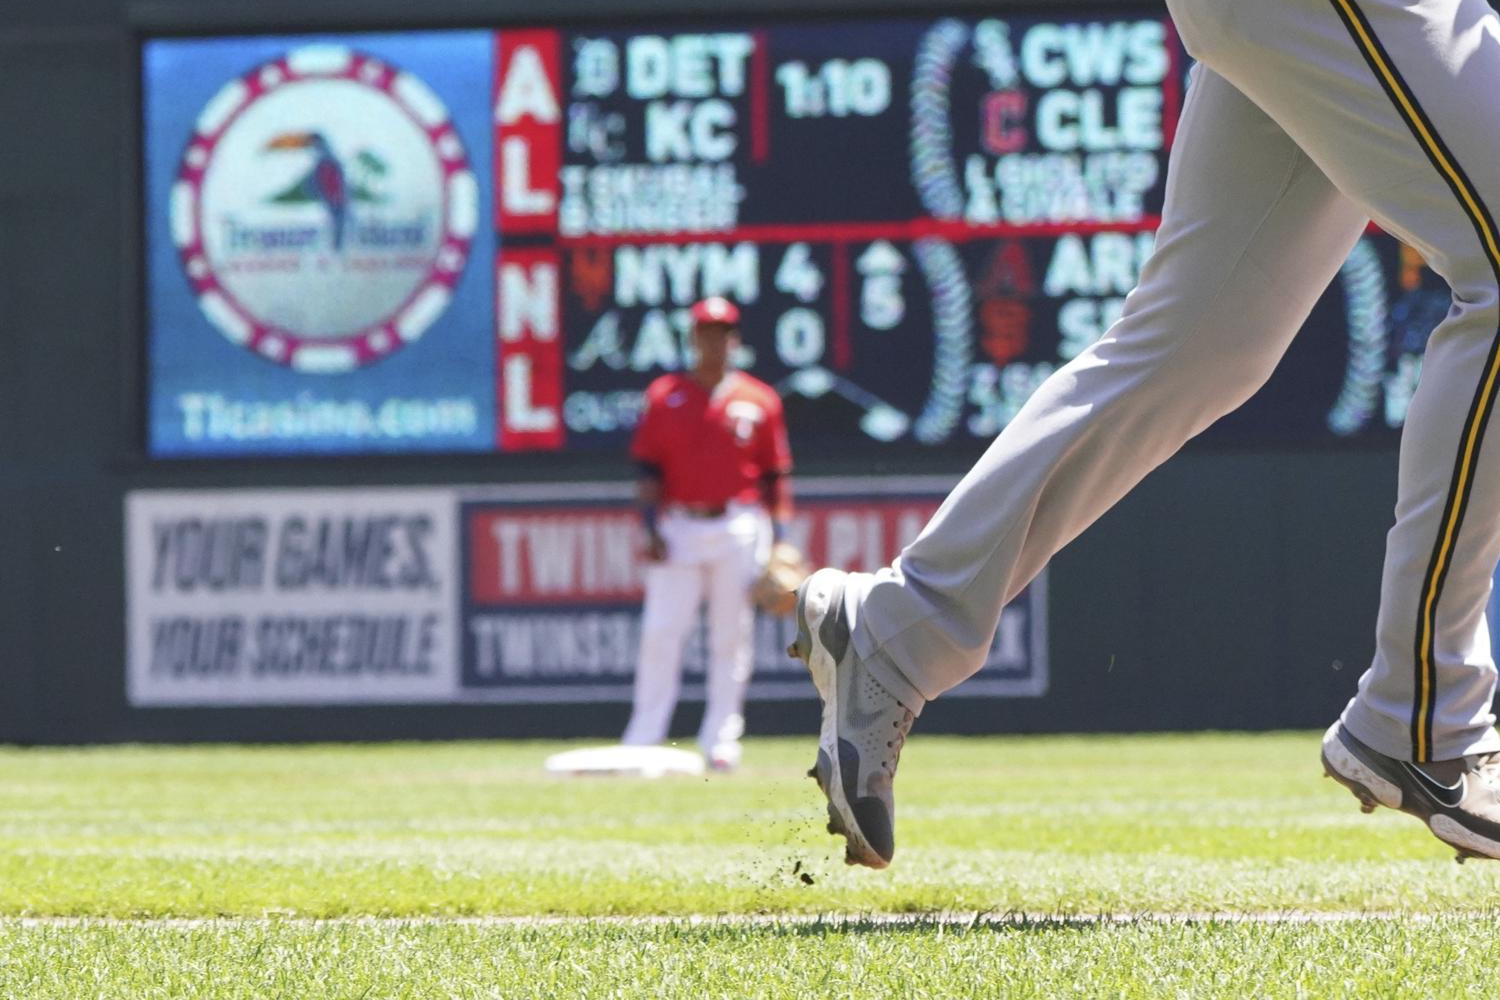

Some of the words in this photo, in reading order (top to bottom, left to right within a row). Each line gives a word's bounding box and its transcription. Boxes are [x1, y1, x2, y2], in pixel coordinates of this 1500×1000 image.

[626, 32, 755, 98] DET
[775, 57, 892, 118] 1:10
[1021, 20, 1170, 89] CWS
[645, 100, 739, 162] KC
[1036, 86, 1165, 152] CLE
[614, 241, 760, 306] NYM
[775, 242, 825, 303] 4
[775, 307, 826, 368] 0
[153, 515, 266, 593] YOUR
[151, 614, 244, 679] YOUR
